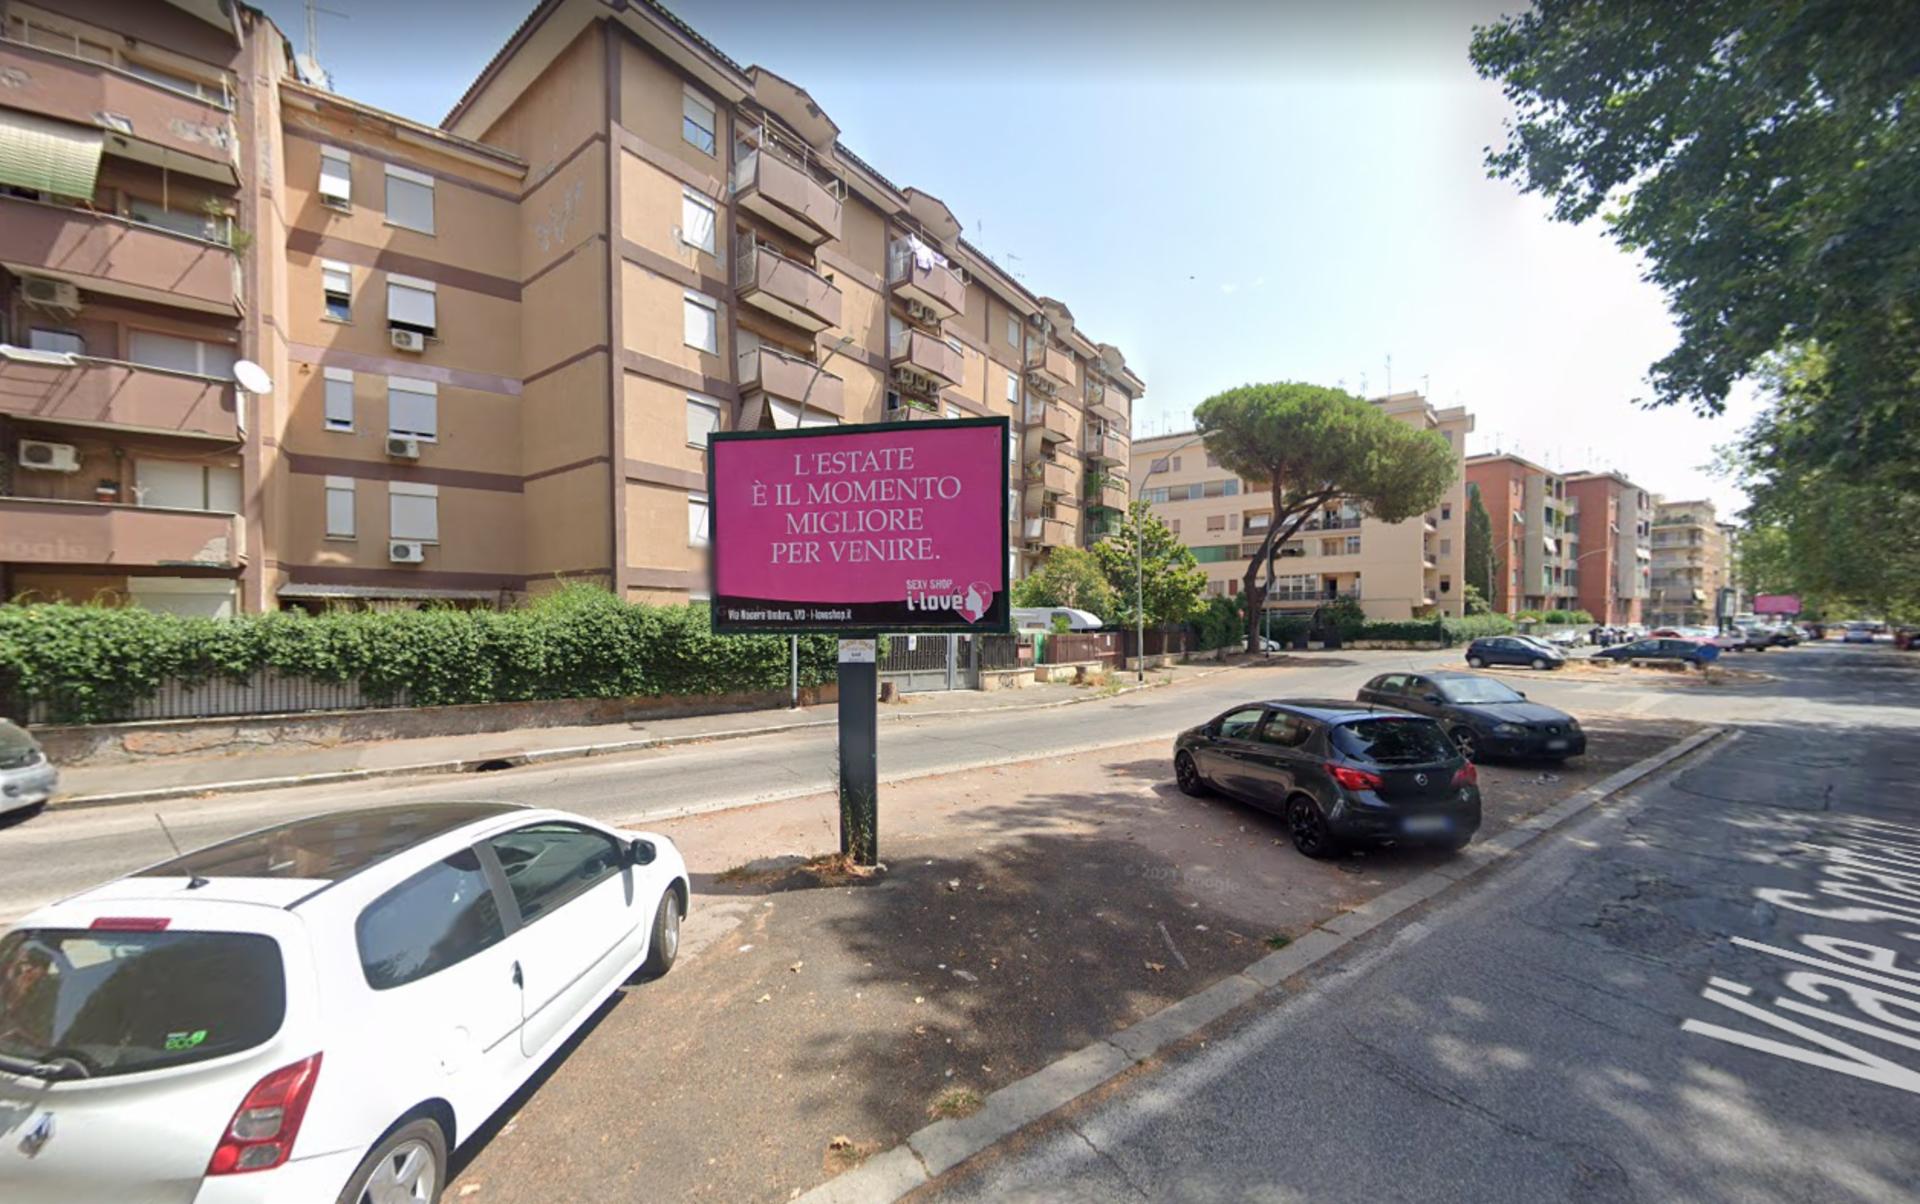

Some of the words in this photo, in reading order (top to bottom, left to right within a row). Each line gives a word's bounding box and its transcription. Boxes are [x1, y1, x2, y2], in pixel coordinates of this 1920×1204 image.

[794, 447, 915, 476] L'ESTATE
[752, 480, 768, 506] È
[775, 483, 801, 506] IL
[806, 475, 962, 505] MOMENTO
[785, 507, 924, 535] MIGLIORE
[770, 542, 821, 564] PER
[829, 537, 941, 562] VENIRE.
[905, 579, 928, 590] SEXY
[929, 578, 953, 589] SHOP
[727, 608, 740, 620] Via
[740, 608, 766, 620] Nocera
[766, 609, 793, 621] Umbra,
